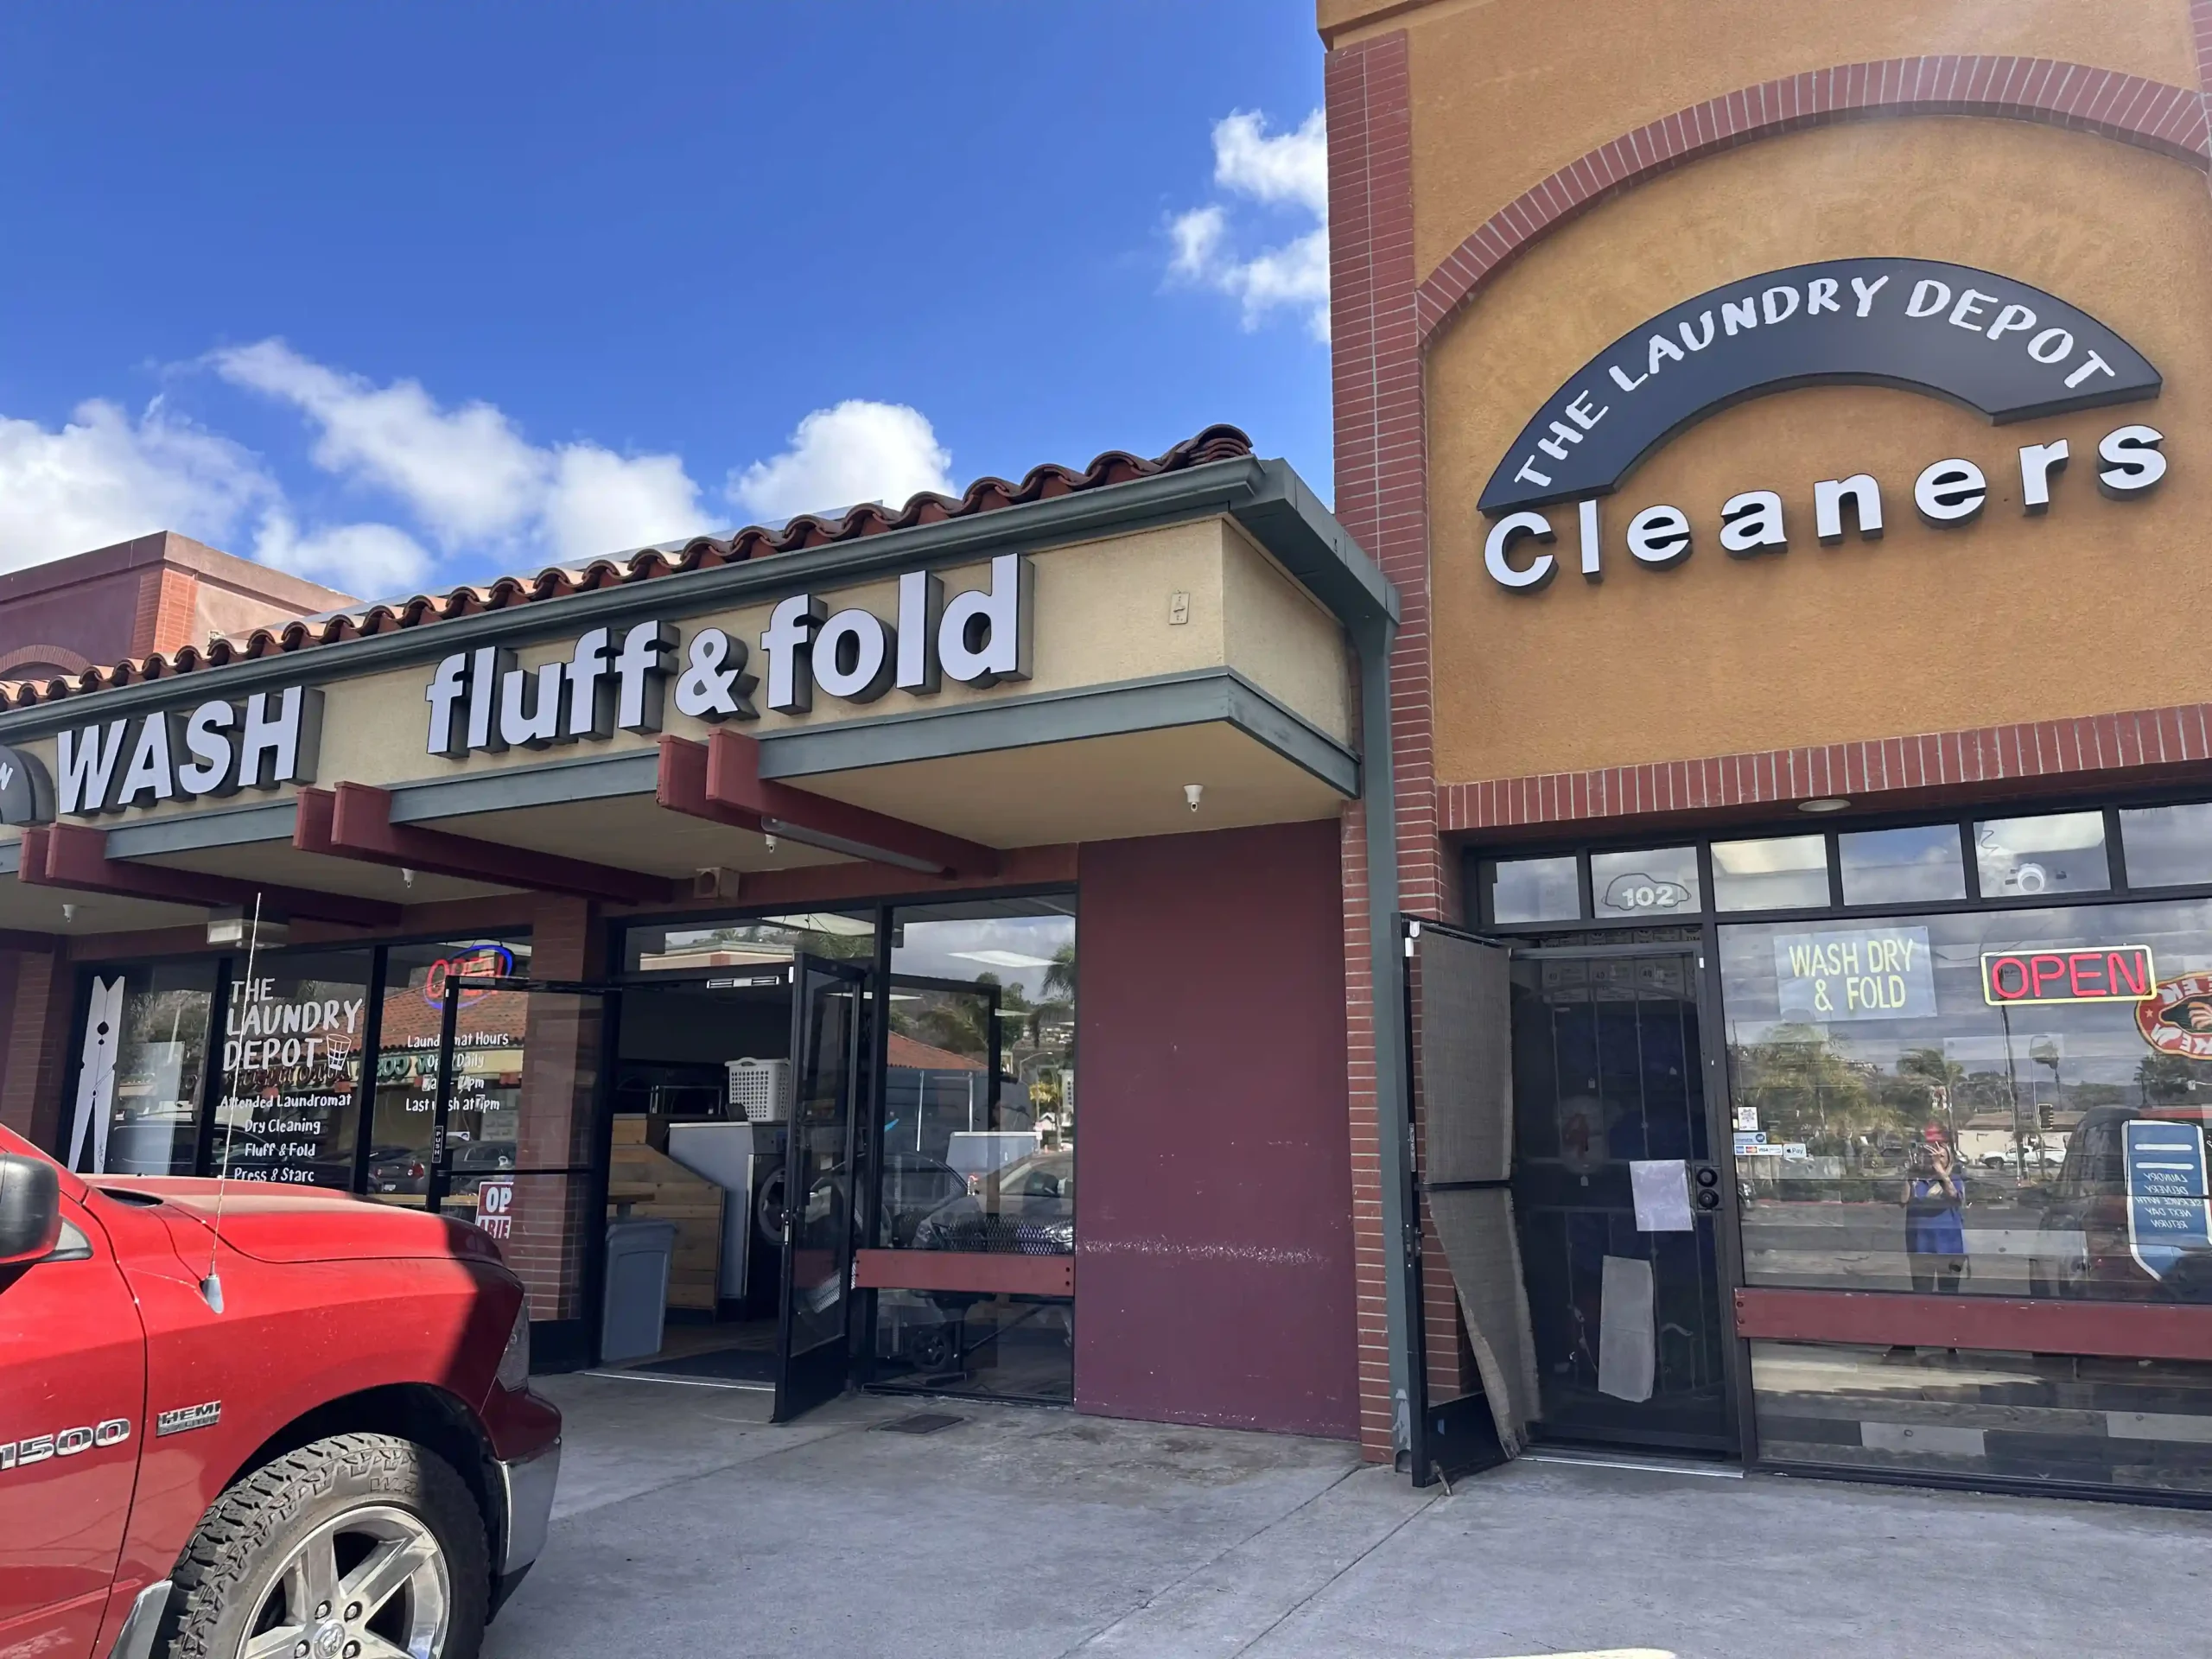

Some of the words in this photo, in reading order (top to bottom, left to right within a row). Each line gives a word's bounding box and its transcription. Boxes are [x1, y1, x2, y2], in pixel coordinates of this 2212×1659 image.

[1514, 389, 1609, 490] THE
[1609, 275, 1890, 392] LAUNDRY
[1904, 279, 2115, 390] DEPOT
[1483, 423, 2169, 588] Cleaners
[425, 619, 662, 755] fluff
[675, 626, 741, 719] &
[760, 552, 1020, 714] fold
[57, 685, 305, 815] WASH
[1622, 885, 1675, 907] 102
[1789, 941, 1859, 977] WASH
[1867, 938, 1914, 973] DRY
[1991, 951, 2146, 999] OPEN
[231, 977, 276, 1003] THE
[1815, 978, 1834, 1012] &
[1847, 975, 1906, 1011] FOLD
[226, 998, 363, 1036] LAUNDRY
[407, 1033, 473, 1048] Laundmat
[475, 1031, 509, 1046] Hours
[222, 1038, 323, 1071] DEPOT
[457, 1053, 485, 1068] Daily
[219, 1095, 273, 1109] Attended
[276, 1094, 353, 1108] Laundromat
[406, 1098, 429, 1112] Last
[245, 1120, 265, 1134] Dry
[268, 1118, 321, 1135] Cleaning
[245, 1142, 276, 1157] Fluff
[278, 1143, 287, 1157] &
[289, 1142, 316, 1157] Fold
[234, 1167, 268, 1182] Press
[280, 1166, 315, 1183] Starc
[162, 1402, 221, 1424] HEMI
[0, 1418, 131, 1470] 1500
